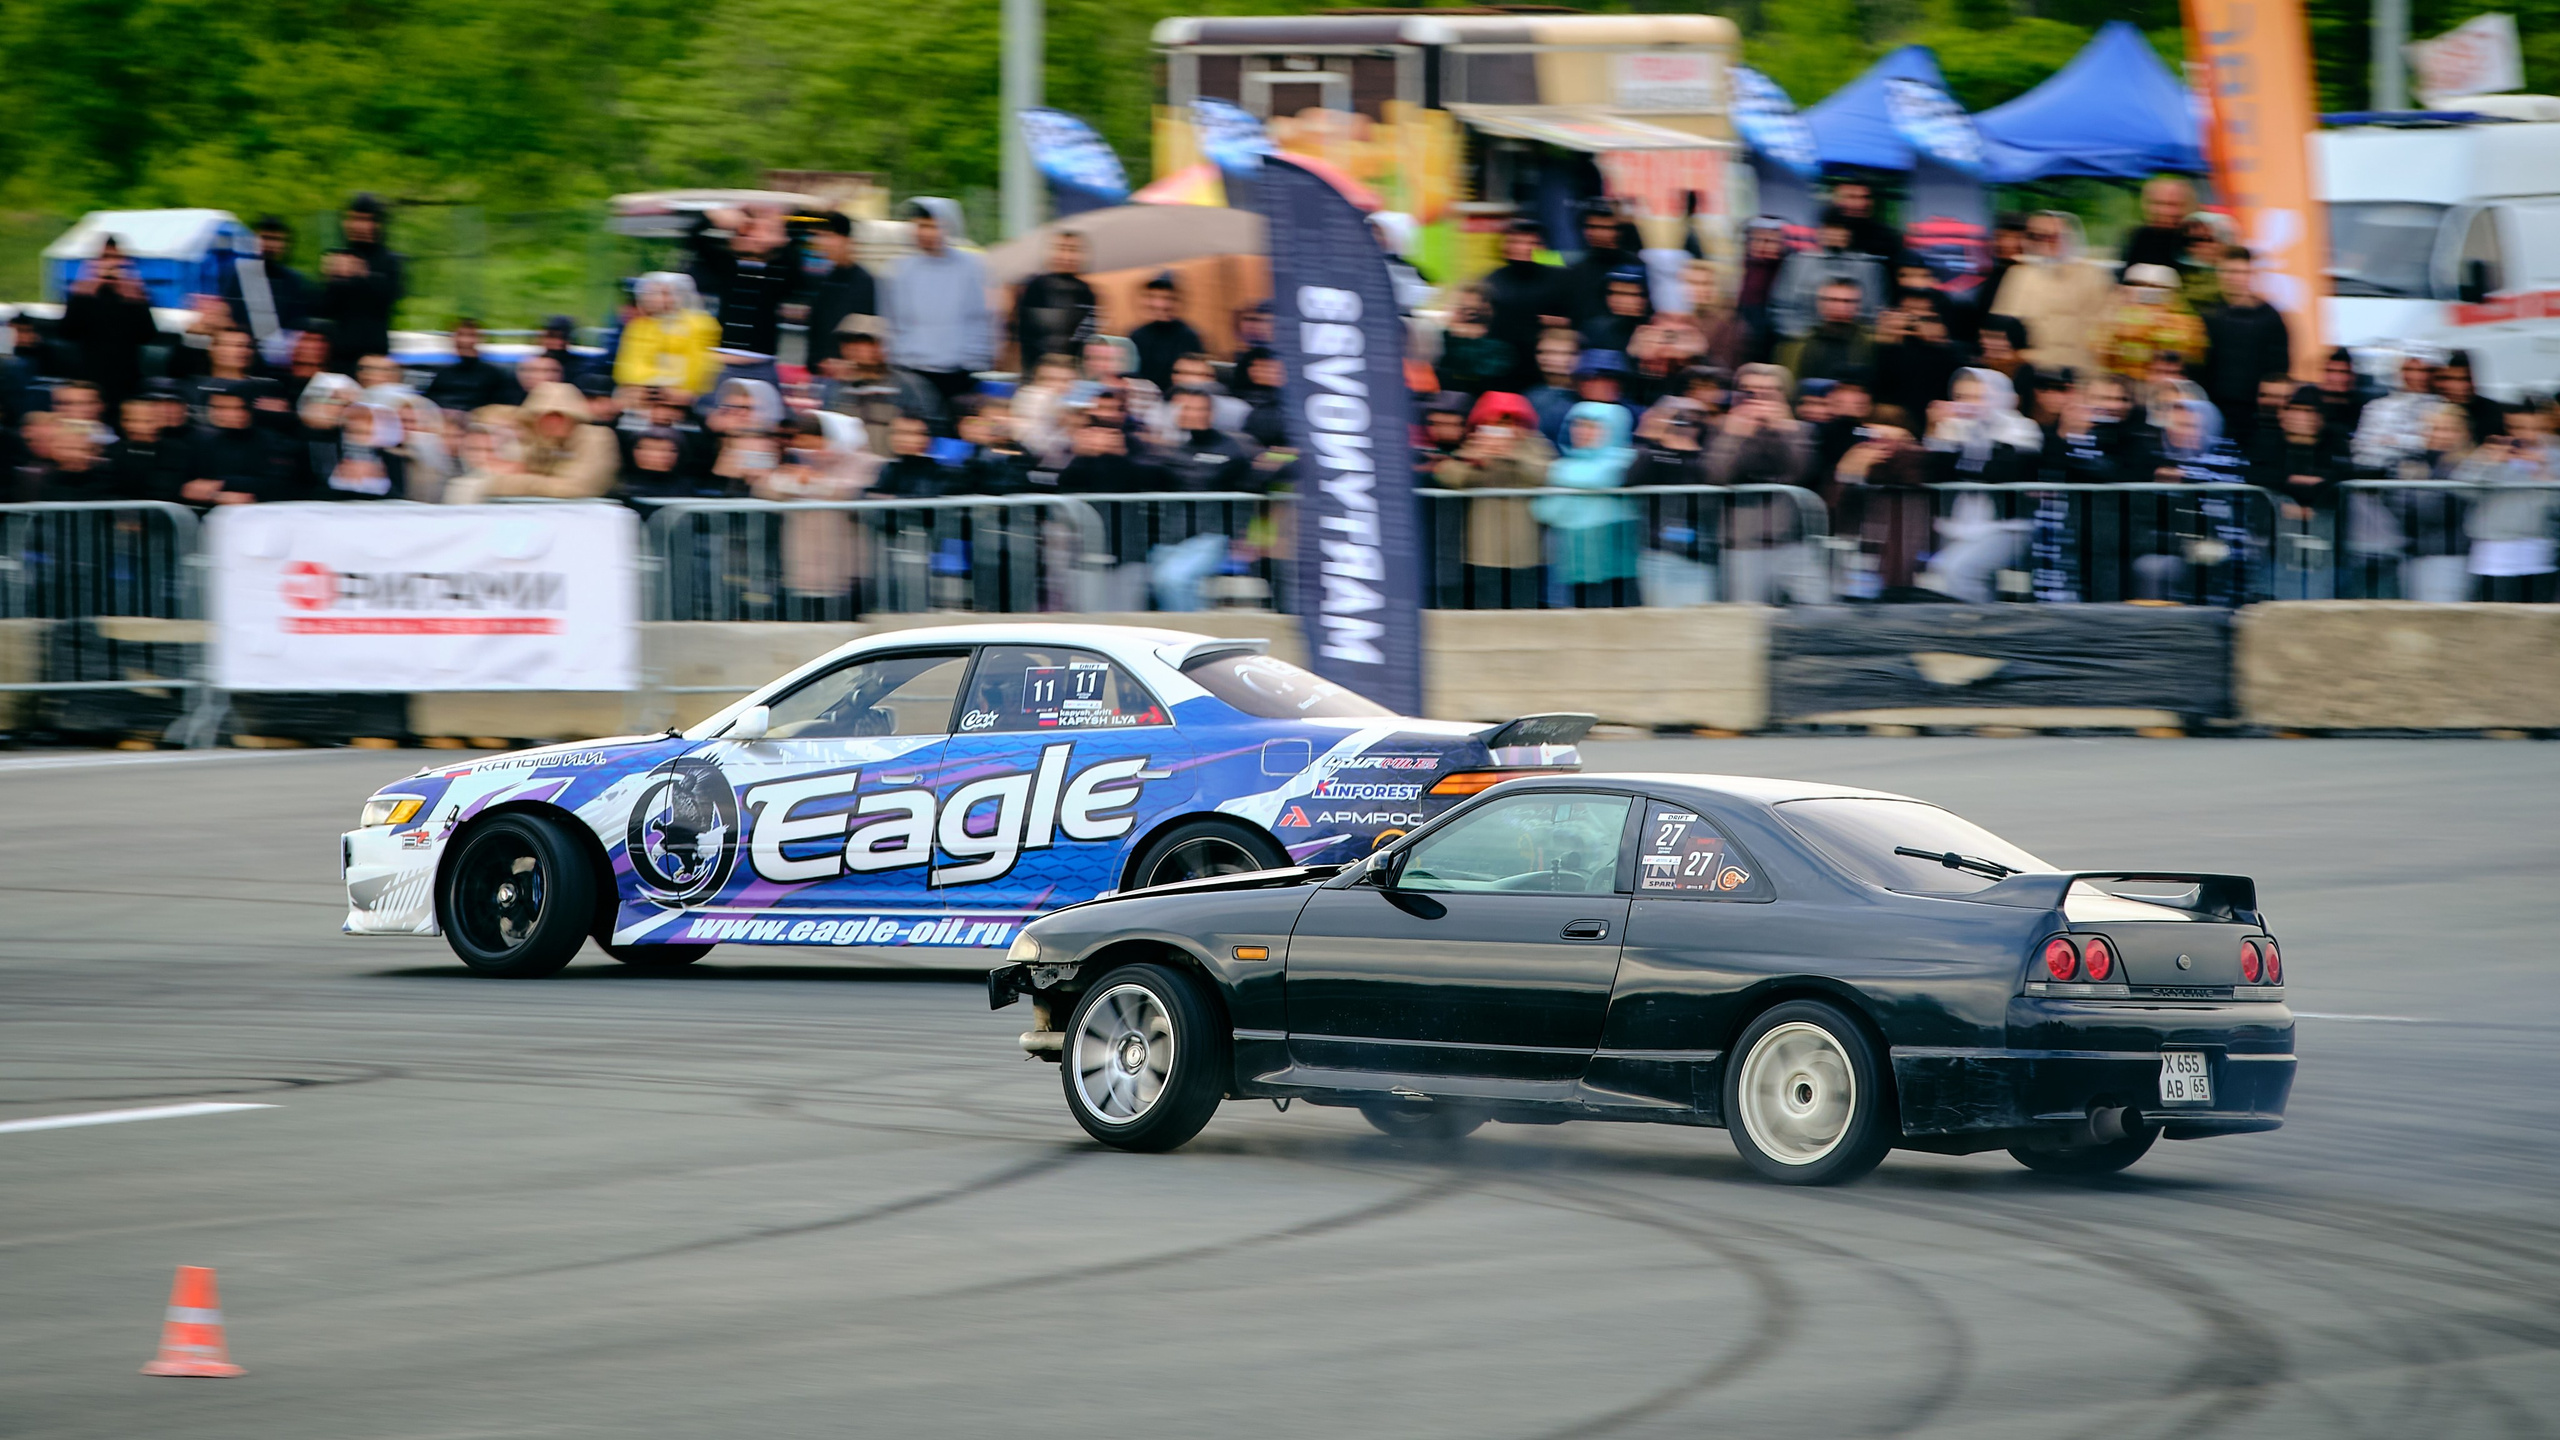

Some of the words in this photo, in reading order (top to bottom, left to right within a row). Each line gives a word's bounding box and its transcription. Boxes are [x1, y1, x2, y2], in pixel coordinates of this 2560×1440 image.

[1034, 680, 1055, 702] 11
[1076, 671, 1098, 693] 11
[1058, 716, 1108, 726] KAPYSH
[1111, 715, 1136, 725] ILYA
[744, 741, 1150, 889] Eagle
[1655, 823, 1686, 847] 27
[1684, 851, 1714, 877] 27
[686, 916, 1012, 945] www.eagle-oil.ru
[2152, 988, 2214, 998] SKYLINE
[2177, 1054, 2199, 1073] 655
[2193, 1078, 2205, 1093] 65
